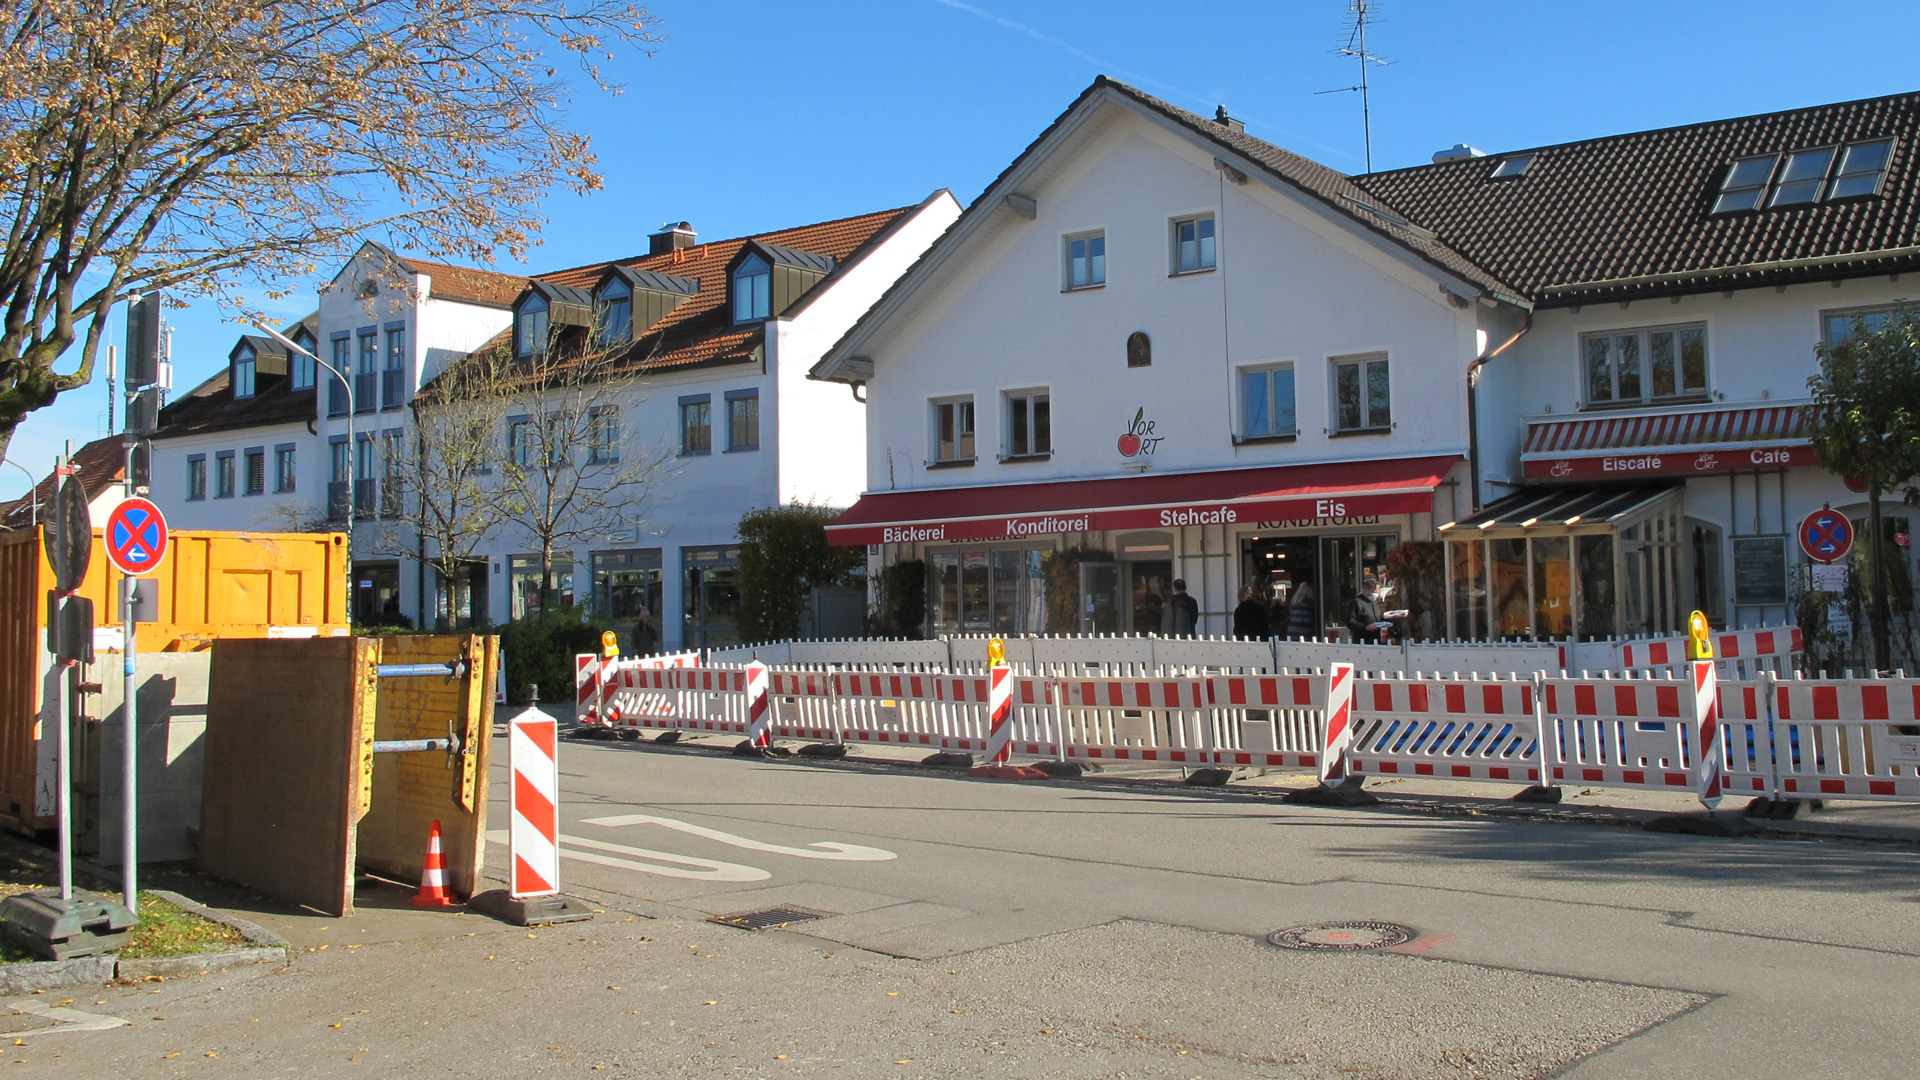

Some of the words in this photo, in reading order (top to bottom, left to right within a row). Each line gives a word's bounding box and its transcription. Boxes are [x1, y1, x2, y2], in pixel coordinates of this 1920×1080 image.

[1602, 455, 1661, 472] Eiscafé
[1750, 447, 1790, 464] Café
[883, 524, 945, 543] Bäckerei
[1006, 514, 1089, 536] Konditorei
[1160, 505, 1237, 527] Stehcafe
[1316, 499, 1346, 518] Eis
